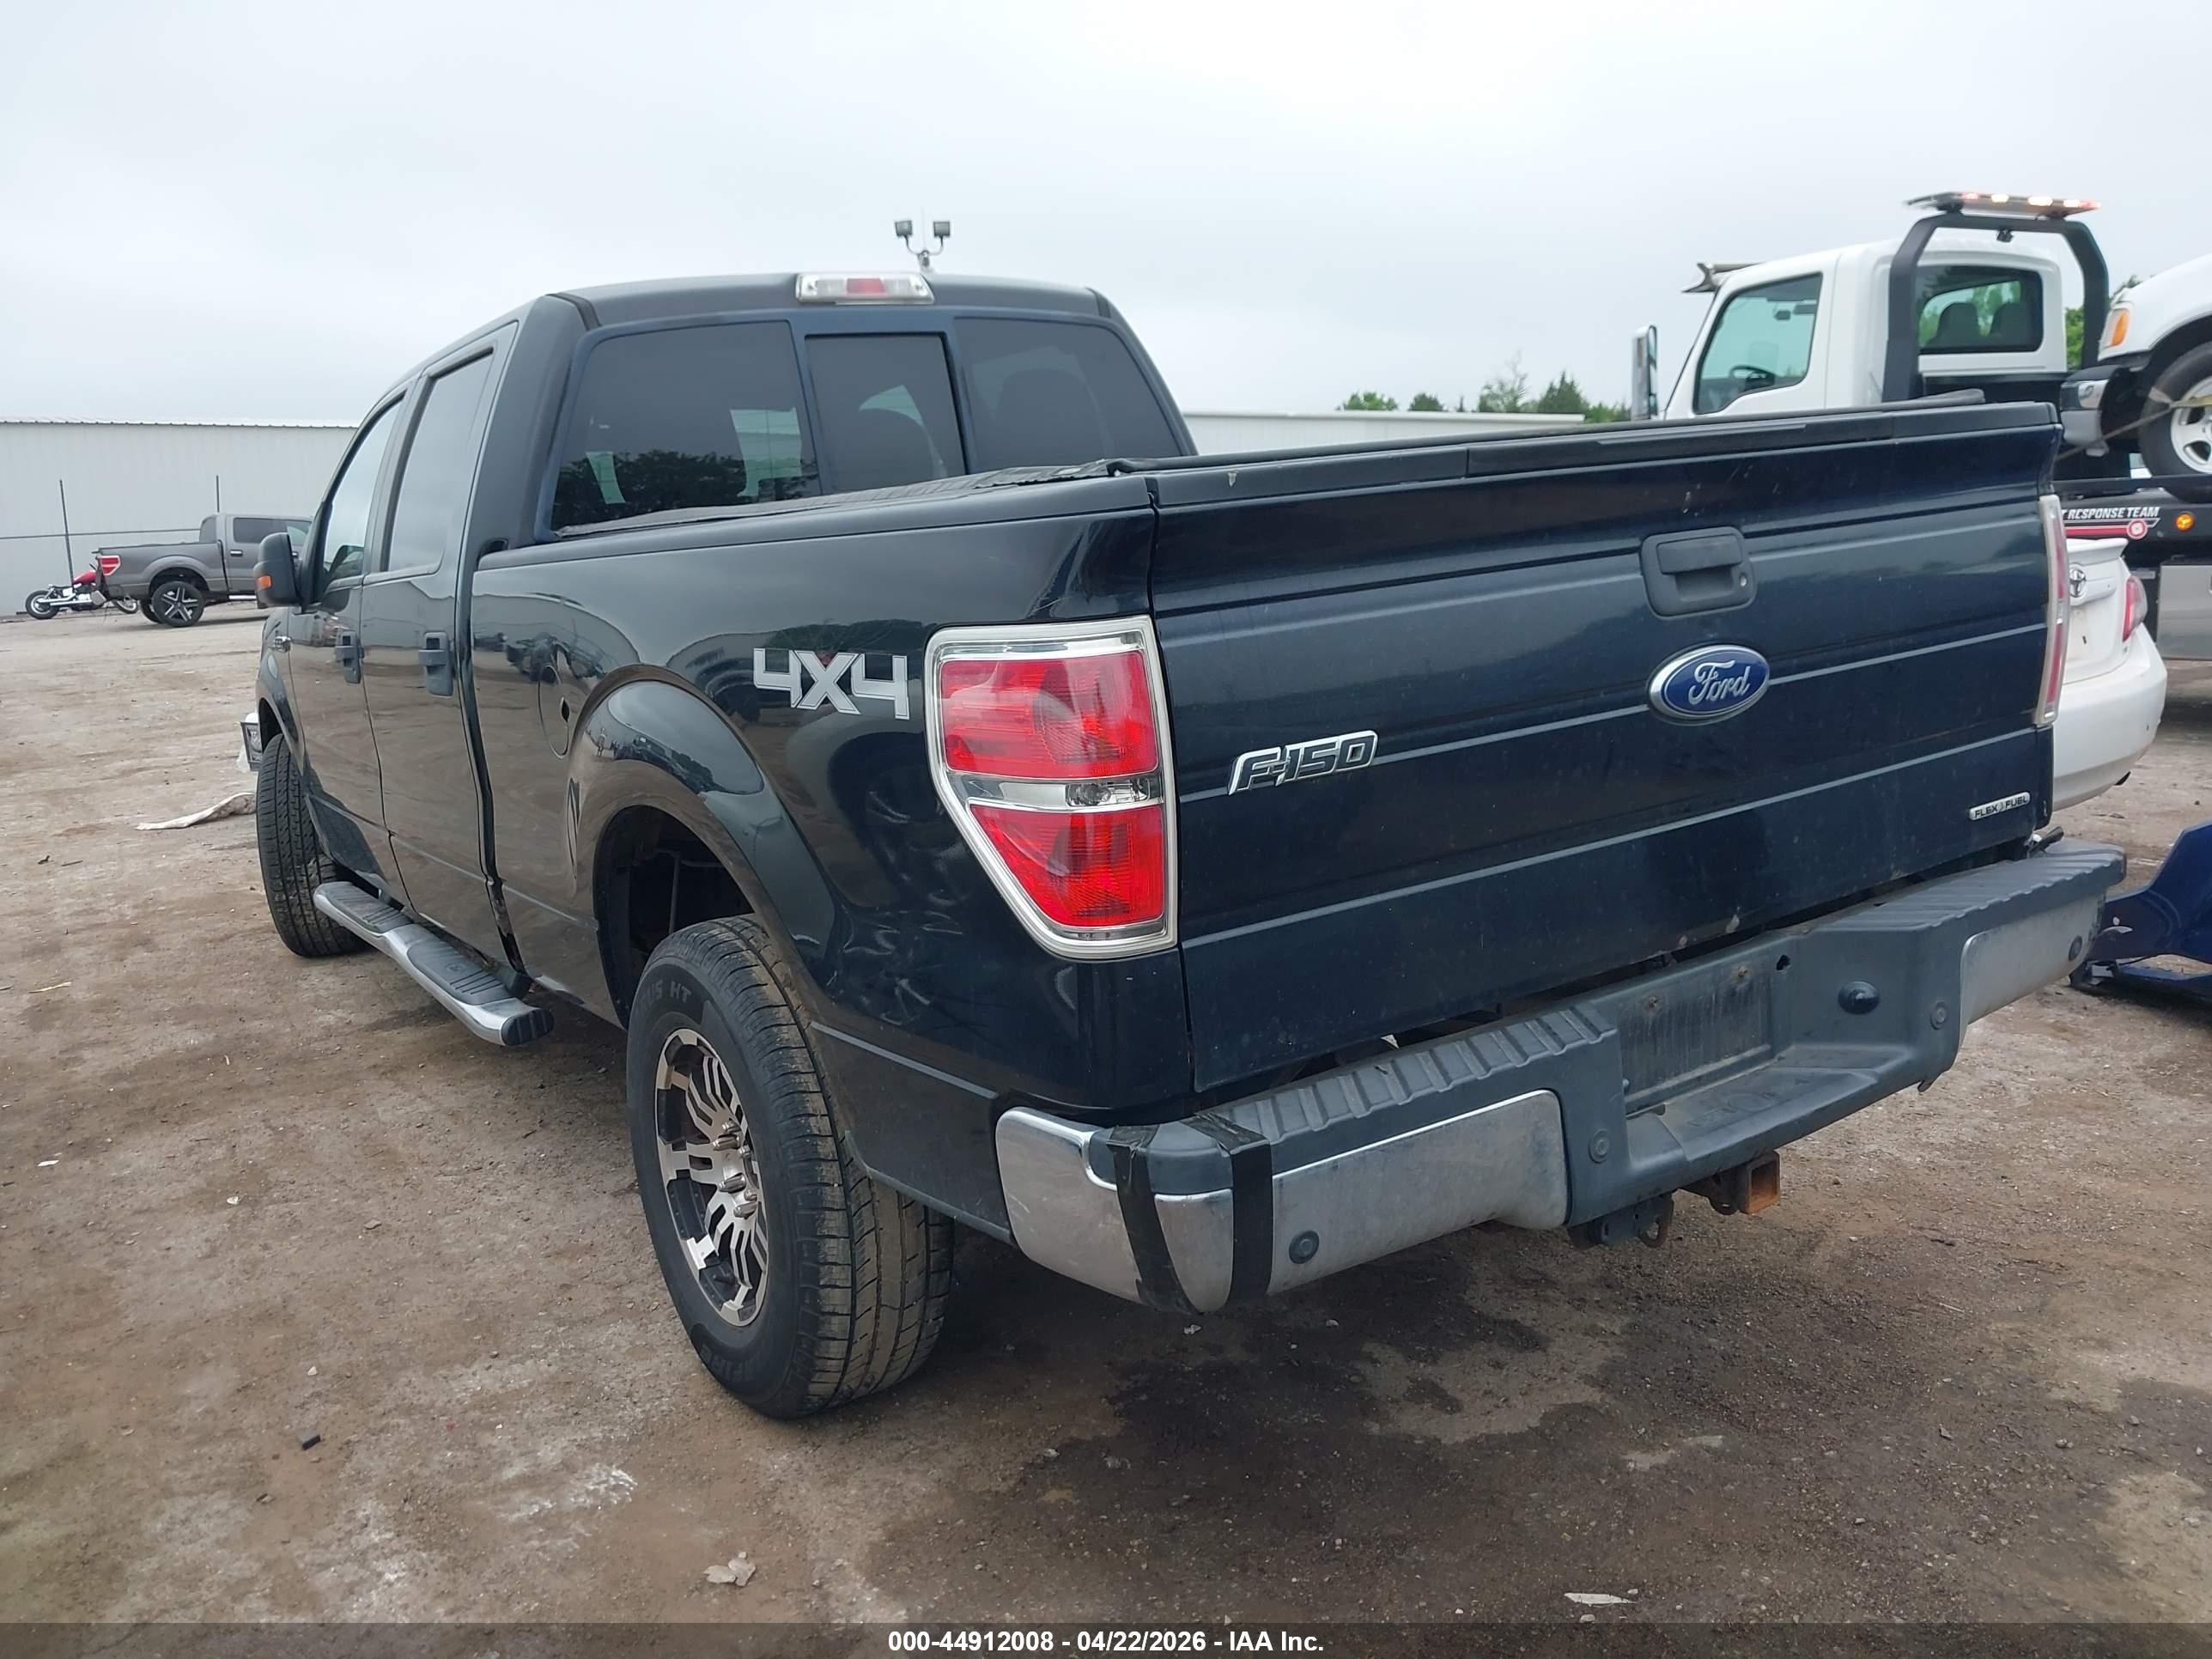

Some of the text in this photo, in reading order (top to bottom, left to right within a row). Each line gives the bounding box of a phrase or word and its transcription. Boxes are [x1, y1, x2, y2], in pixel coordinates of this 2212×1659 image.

[2067, 507, 2125, 520] RESPONSE
[2126, 506, 2160, 519] TEAM
[1687, 659, 1751, 705] Ford
[1228, 729, 1378, 796] F-150
[1975, 795, 2027, 817] FLEX FUEL
